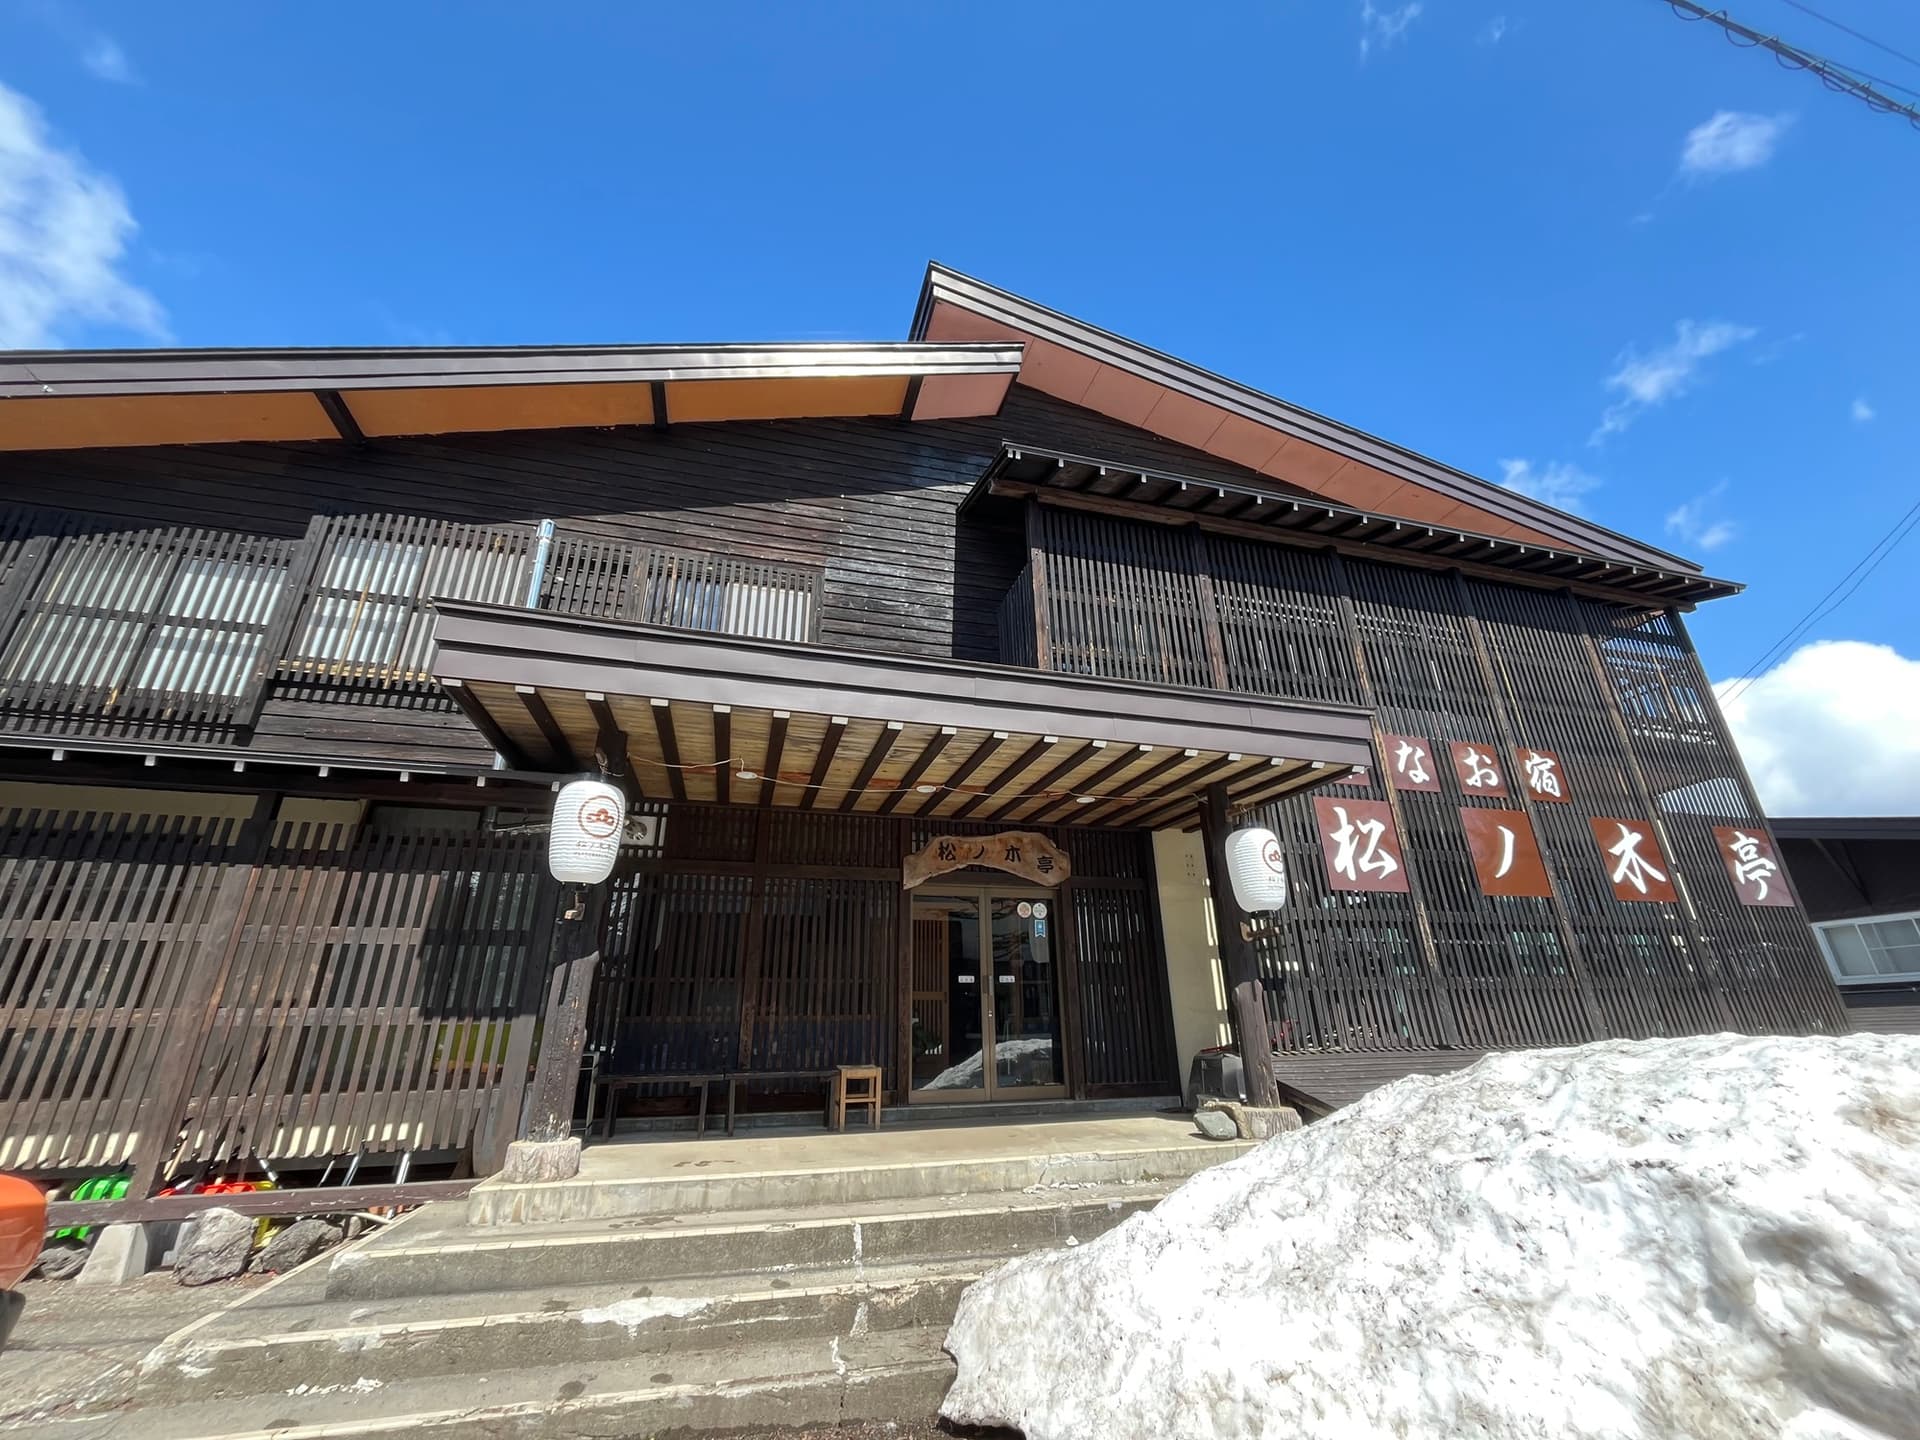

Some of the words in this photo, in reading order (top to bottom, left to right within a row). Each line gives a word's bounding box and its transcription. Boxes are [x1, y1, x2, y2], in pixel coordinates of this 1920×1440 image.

[1348, 741, 1560, 797] なお宿
[938, 842, 1054, 873] 松ノ木亭
[1330, 807, 1776, 900] 松ノ木亭
